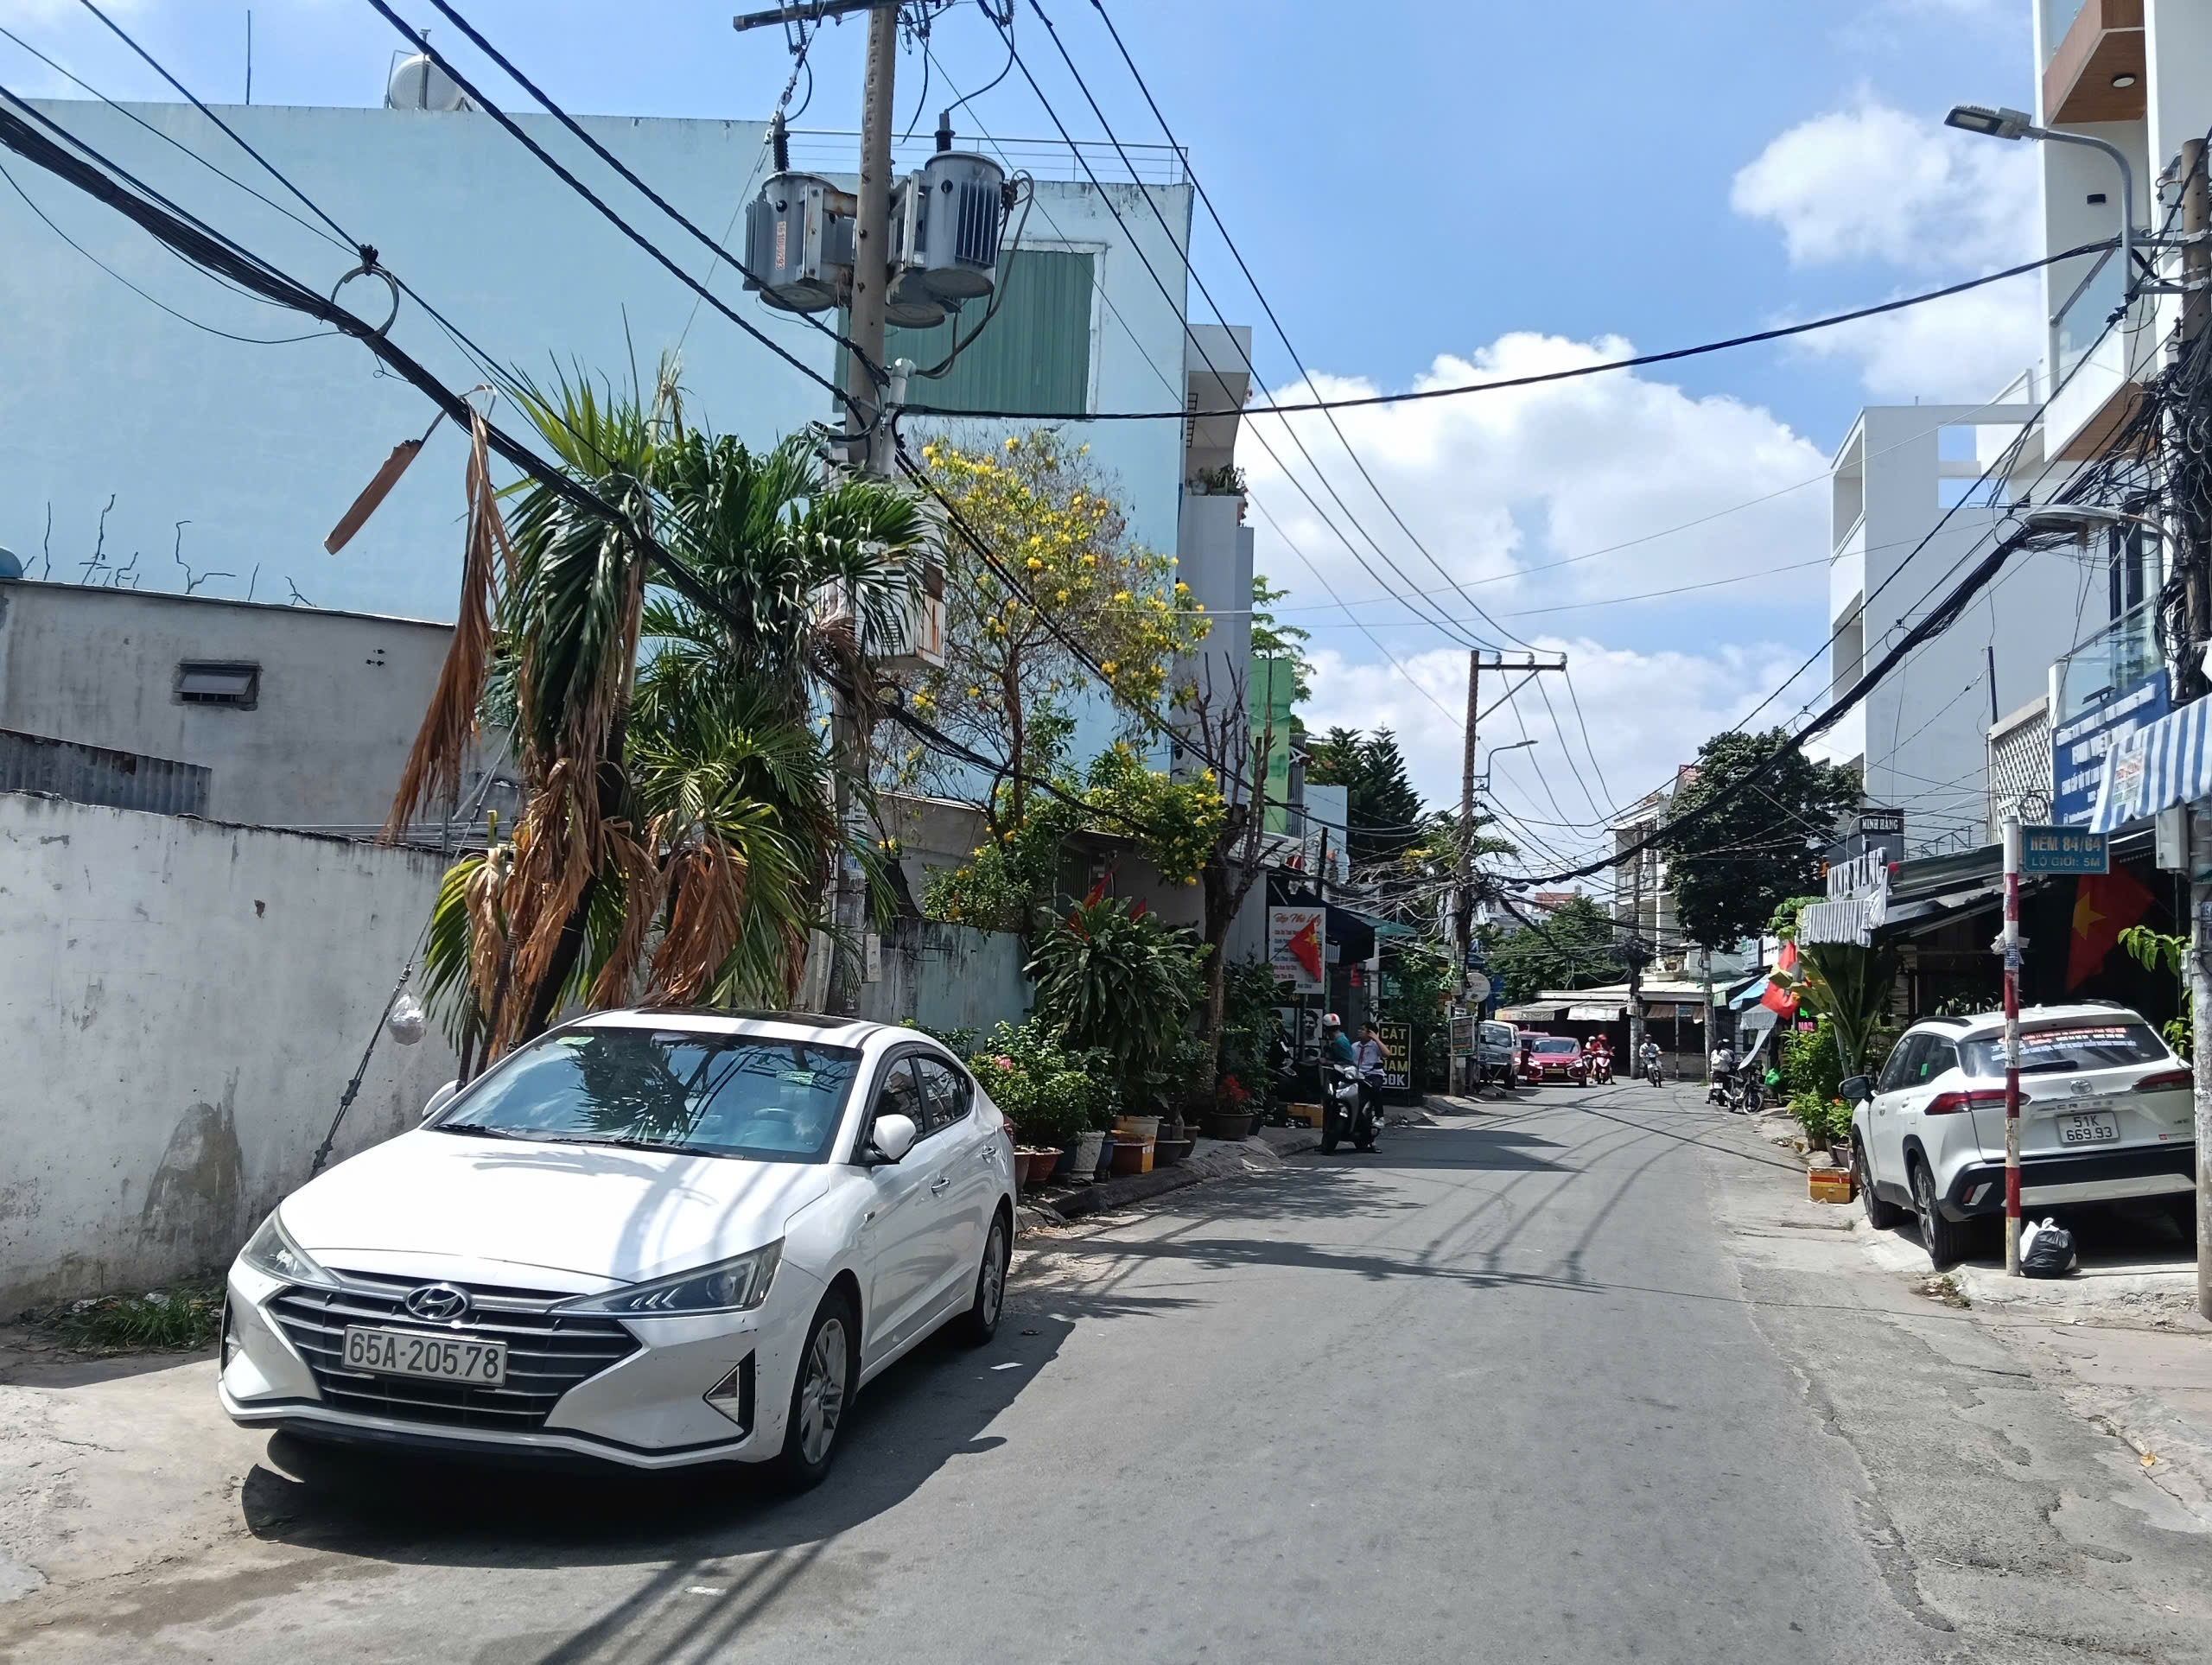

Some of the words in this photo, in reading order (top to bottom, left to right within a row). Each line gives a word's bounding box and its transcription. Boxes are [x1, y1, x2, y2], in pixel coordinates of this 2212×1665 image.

[1861, 818, 1878, 829] MINH
[2074, 1115, 2100, 1128] 51K
[2066, 1127, 2113, 1141] 669.93
[349, 1332, 499, 1379] 65A-205.78
